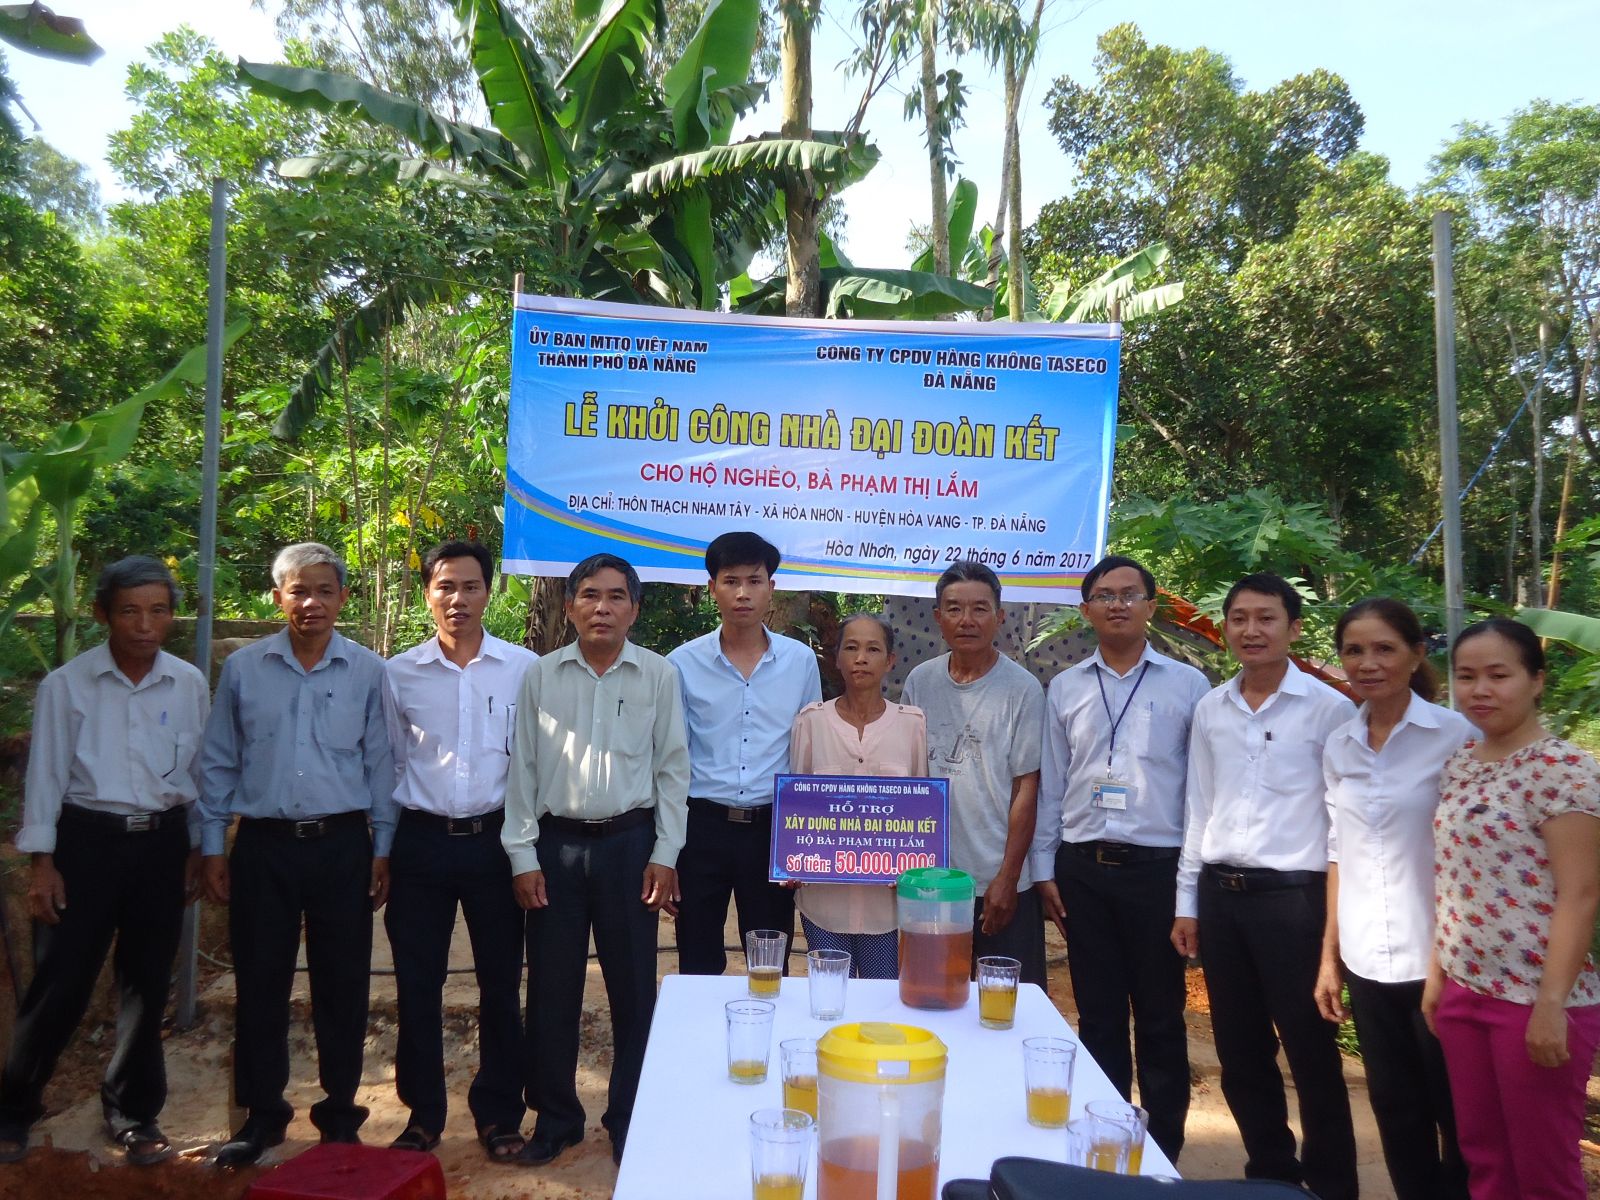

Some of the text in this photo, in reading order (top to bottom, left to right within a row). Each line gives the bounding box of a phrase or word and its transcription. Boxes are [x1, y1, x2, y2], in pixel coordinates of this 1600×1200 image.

[529, 327, 708, 353] ỦY BAN MTTQ VIỆT NAM
[538, 350, 696, 374] THÀNH PHỐ ĐÀ NẴNG
[817, 345, 1107, 374] CÔNG TY CPDV HÀNG KHÔNG TASECO
[923, 371, 996, 391] ĐÀ NẴNG
[565, 391, 1060, 461] LỄ KHỞI CÔNG NHÀ ĐẠI ĐOÀN KẾT
[640, 462, 978, 499] CHO HỘ NGHÈO, BÀ PHẠM THỊ LẮM
[569, 495, 587, 510] ĐỊA
[591, 492, 615, 511] CHỈ:
[618, 495, 647, 512] THÔN
[651, 499, 687, 515] THẠCH
[692, 503, 726, 517] NHAM
[730, 501, 750, 517] TÂY
[763, 503, 778, 519] XÃ
[783, 503, 807, 520] HÒA
[811, 508, 843, 523] NHƠN
[855, 510, 895, 526] HUYỆN
[899, 512, 923, 527] HÒA
[927, 516, 960, 529] VANG
[972, 517, 986, 530] TP.
[991, 514, 1007, 531] ĐÀ
[1011, 512, 1046, 532] NẴNG
[826, 540, 1091, 569] Hòa Nhơn, ngày 22 tháng 6 năm 2017
[829, 801, 894, 814] HỖ TRỢ
[785, 814, 937, 834] XÂY DỰNG NHÀ ĐẠI ĐOÀN KẾT
[797, 835, 924, 848] HỘ BÀ: PHẠM THỊ LẮM
[787, 853, 803, 871] Số
[804, 854, 830, 872] tiền:
